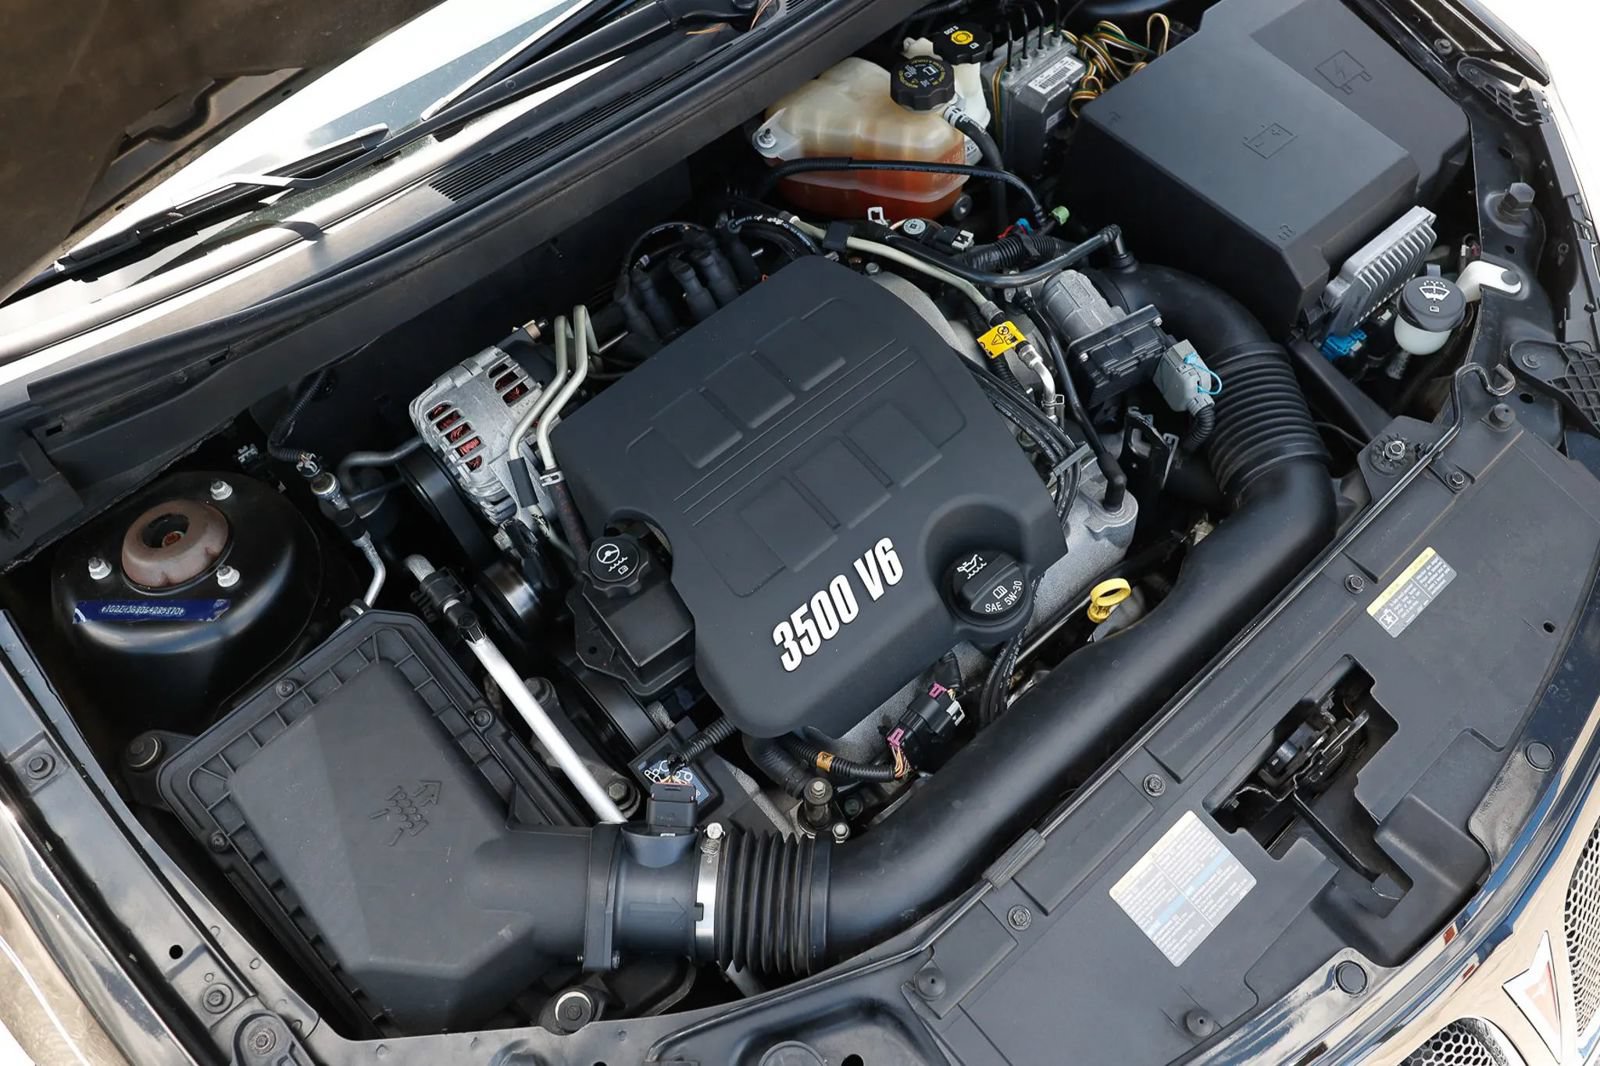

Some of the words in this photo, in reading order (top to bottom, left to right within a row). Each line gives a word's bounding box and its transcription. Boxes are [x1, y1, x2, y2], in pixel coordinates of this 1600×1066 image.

[772, 574, 859, 672] 3500
[853, 537, 904, 601] V6
[985, 601, 1003, 613] SAE
[1003, 580, 1023, 606] 5W-30
